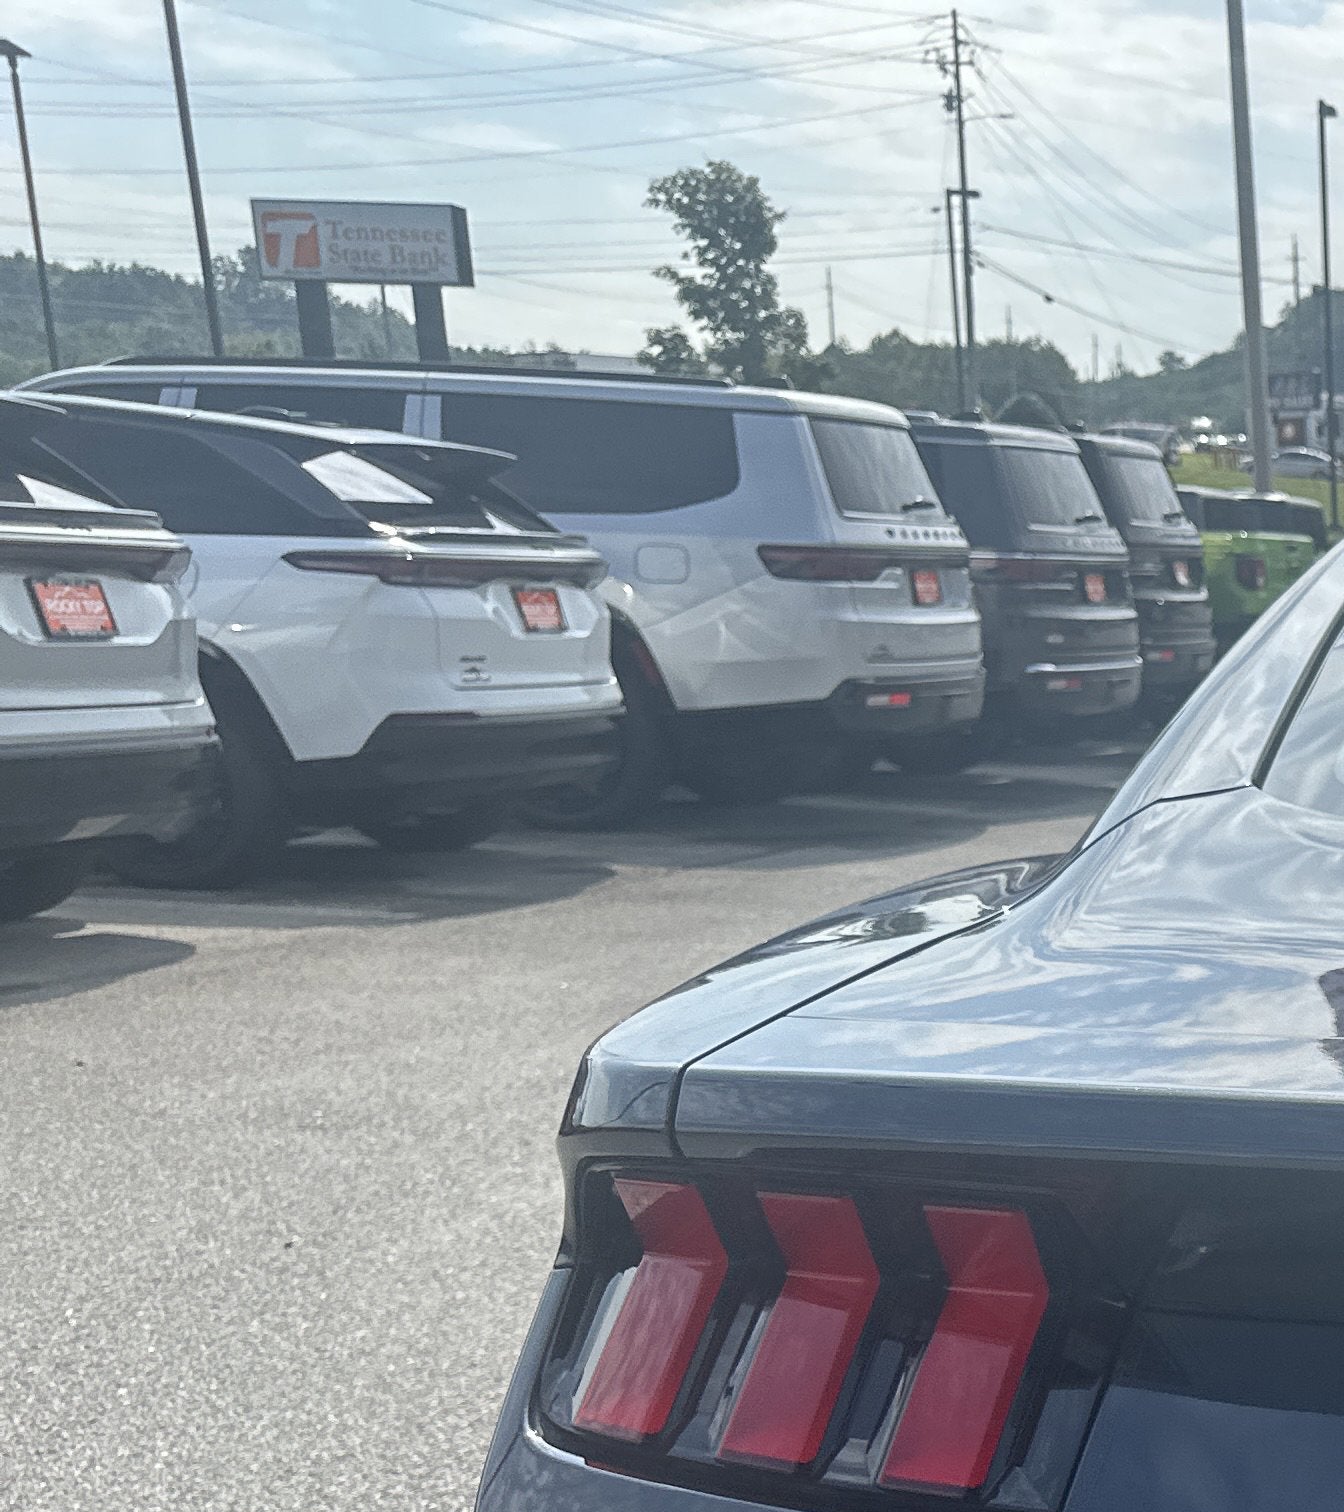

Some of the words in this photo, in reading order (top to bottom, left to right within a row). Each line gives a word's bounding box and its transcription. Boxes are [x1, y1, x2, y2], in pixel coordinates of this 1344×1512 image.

[324, 219, 449, 243] Tennessee
[327, 243, 382, 265] State
[389, 244, 450, 267] Bank
